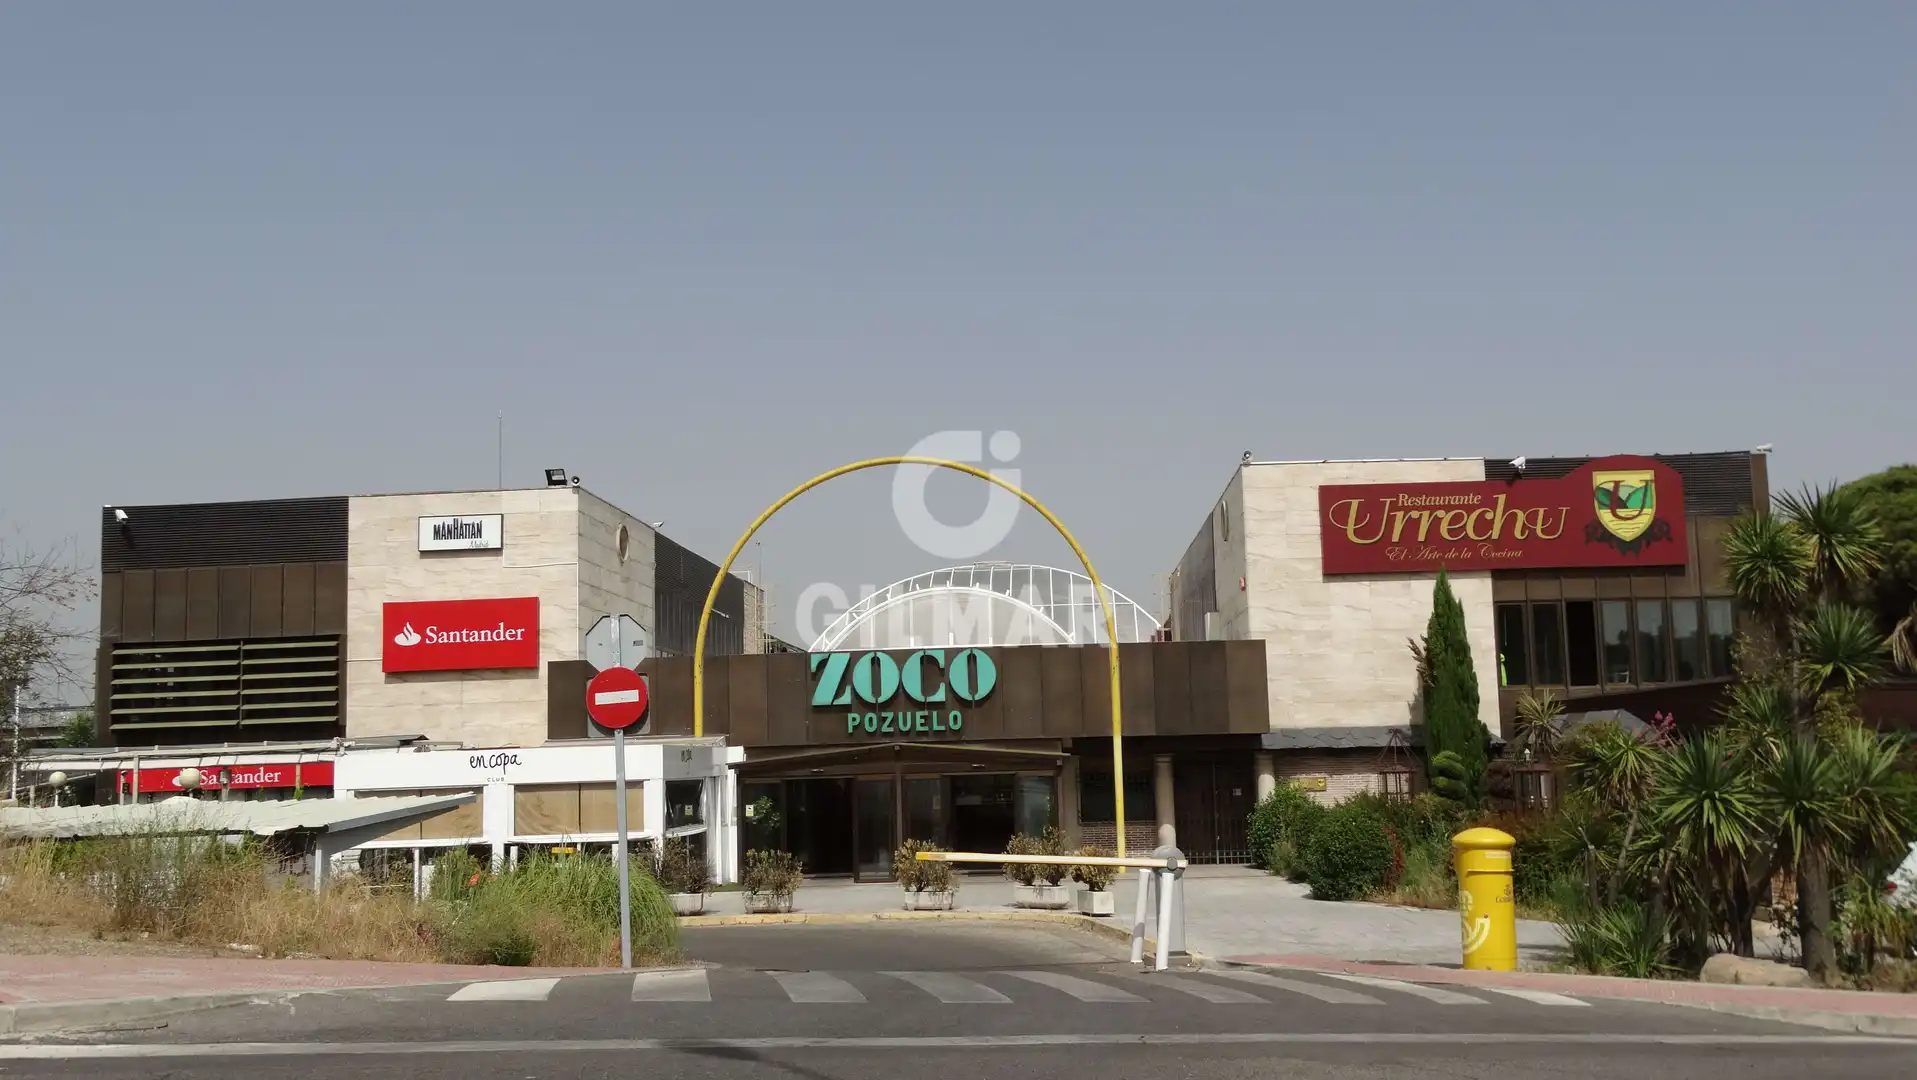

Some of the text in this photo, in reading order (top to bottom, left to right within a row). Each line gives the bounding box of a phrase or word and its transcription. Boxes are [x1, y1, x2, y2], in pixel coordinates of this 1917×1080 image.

[1398, 492, 1482, 507] Restaurante
[1385, 546, 1408, 561] El
[1444, 547, 1459, 560] de
[1460, 547, 1473, 559] la
[425, 621, 525, 644] Santander
[810, 648, 997, 706] ZOCO
[847, 710, 962, 733] POZUELO
[470, 752, 523, 775] en copa
[200, 766, 282, 786] Saander
